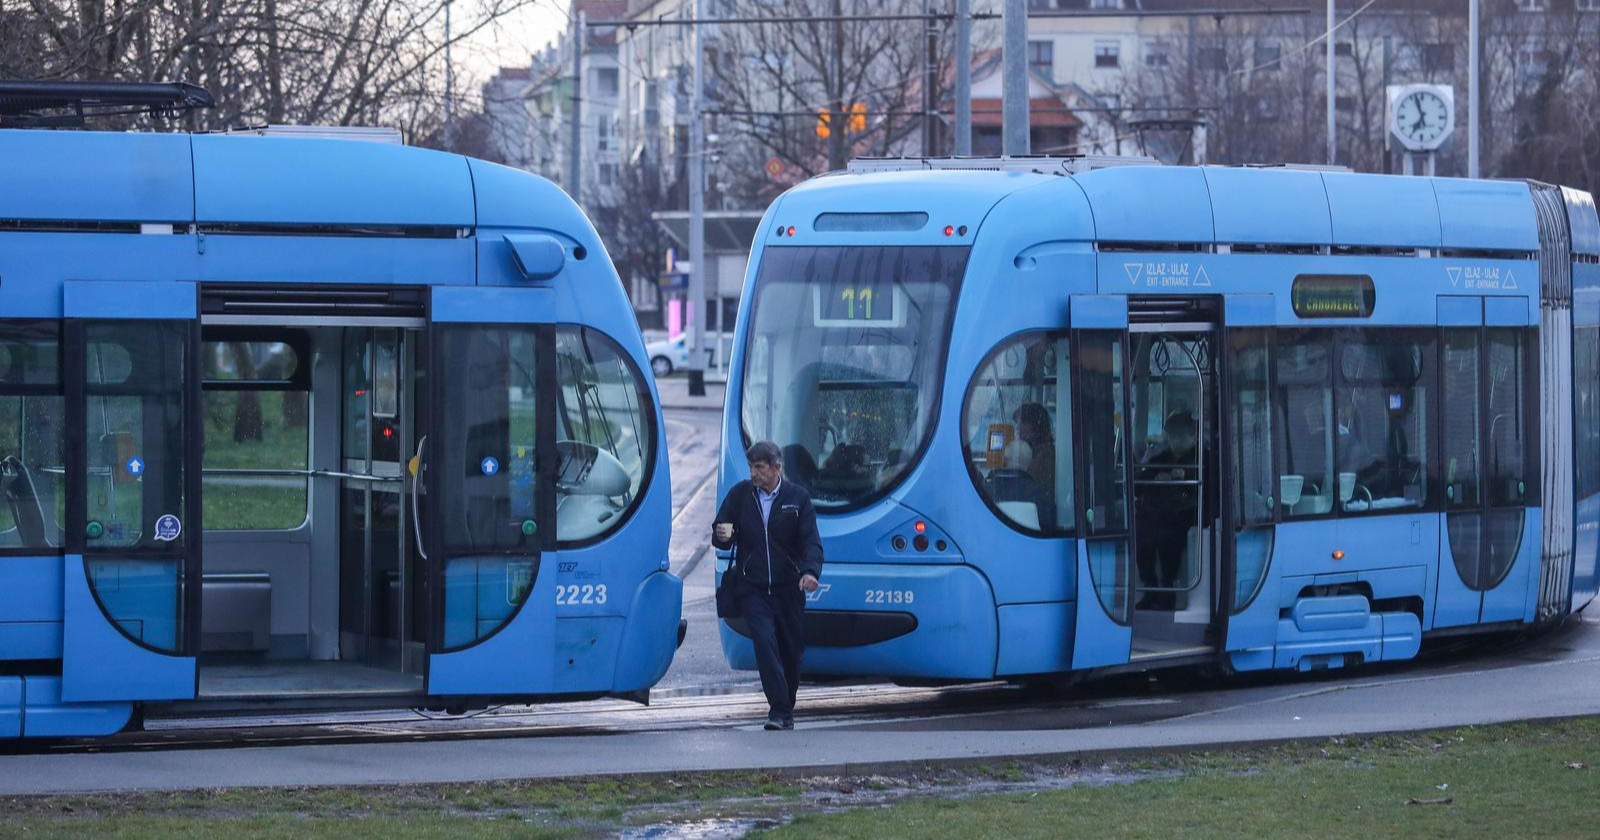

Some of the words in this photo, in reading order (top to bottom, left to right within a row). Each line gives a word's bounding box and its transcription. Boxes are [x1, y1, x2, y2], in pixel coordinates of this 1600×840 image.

[1146, 263, 1166, 276] IZLAZ
[1171, 263, 1189, 276] ULAZ
[1464, 267, 1481, 279] IZLAZ
[1484, 267, 1500, 279] ULAZ
[1147, 276, 1158, 287] EXIT
[1162, 276, 1189, 287] ENTRANCE
[841, 286, 872, 319] 11
[556, 584, 607, 605] 2223
[865, 590, 914, 603] 22139
